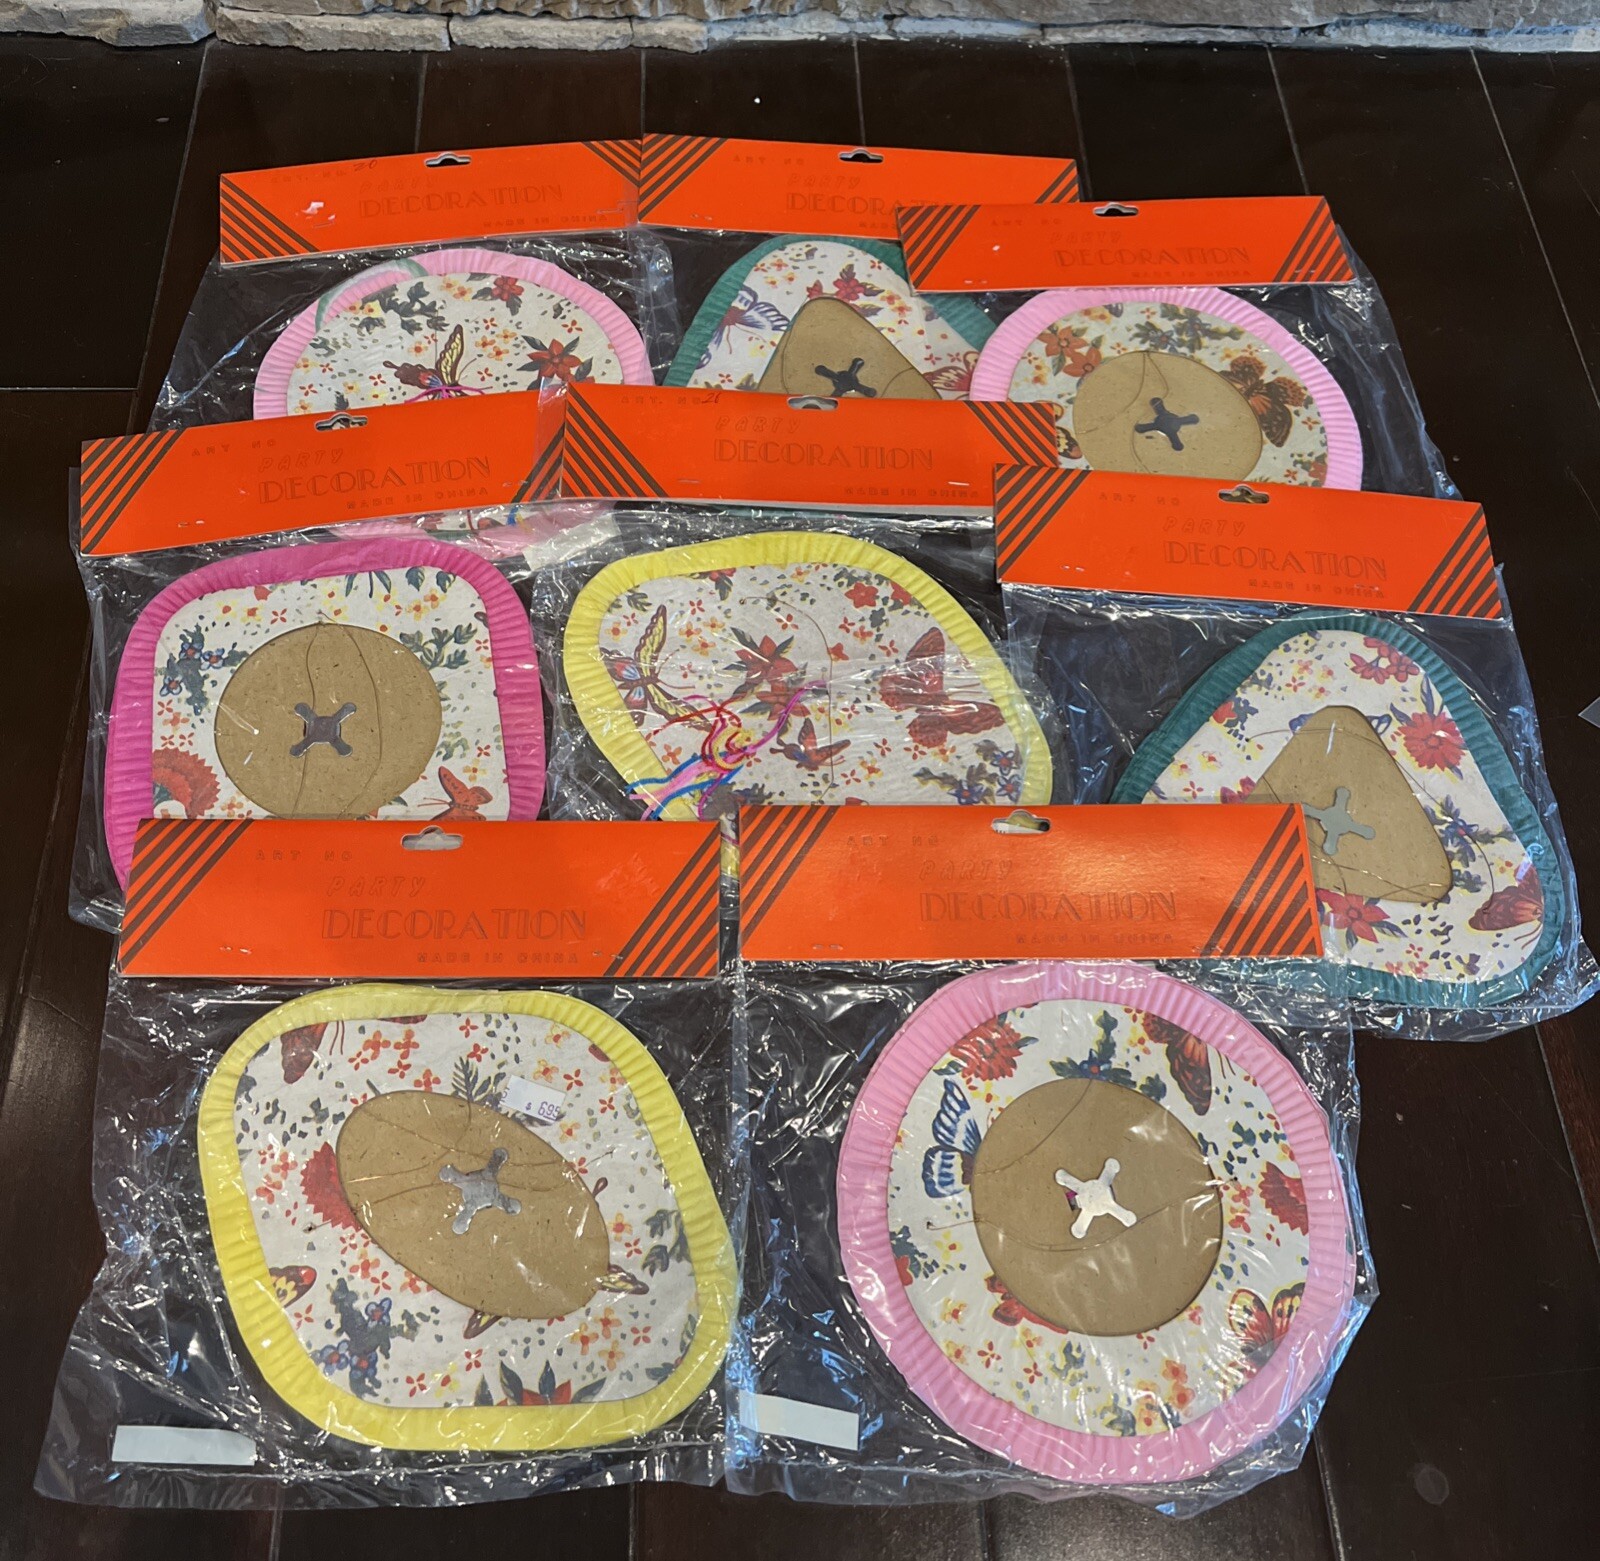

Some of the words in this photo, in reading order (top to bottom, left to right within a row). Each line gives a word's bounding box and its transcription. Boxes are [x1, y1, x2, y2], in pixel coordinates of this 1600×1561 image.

[359, 183, 563, 219] DECORATION
[1054, 246, 1250, 268] DECORATION
[714, 414, 801, 434] PARTY
[258, 447, 344, 473] PARTY
[713, 438, 933, 471] DECORATION
[258, 455, 491, 505] DECORATION
[1162, 515, 1246, 537] PARTY
[1163, 540, 1387, 581] DECORATION
[256, 849, 301, 861] ART
[324, 849, 353, 861] NO
[919, 859, 1013, 881] PARTY
[326, 875, 426, 897] PARTY
[919, 891, 1176, 921] DECORATION
[321, 907, 587, 941] DECORATION
[416, 951, 472, 964] MADE
[485, 952, 503, 964] IN
[517, 951, 579, 964] CHINA
